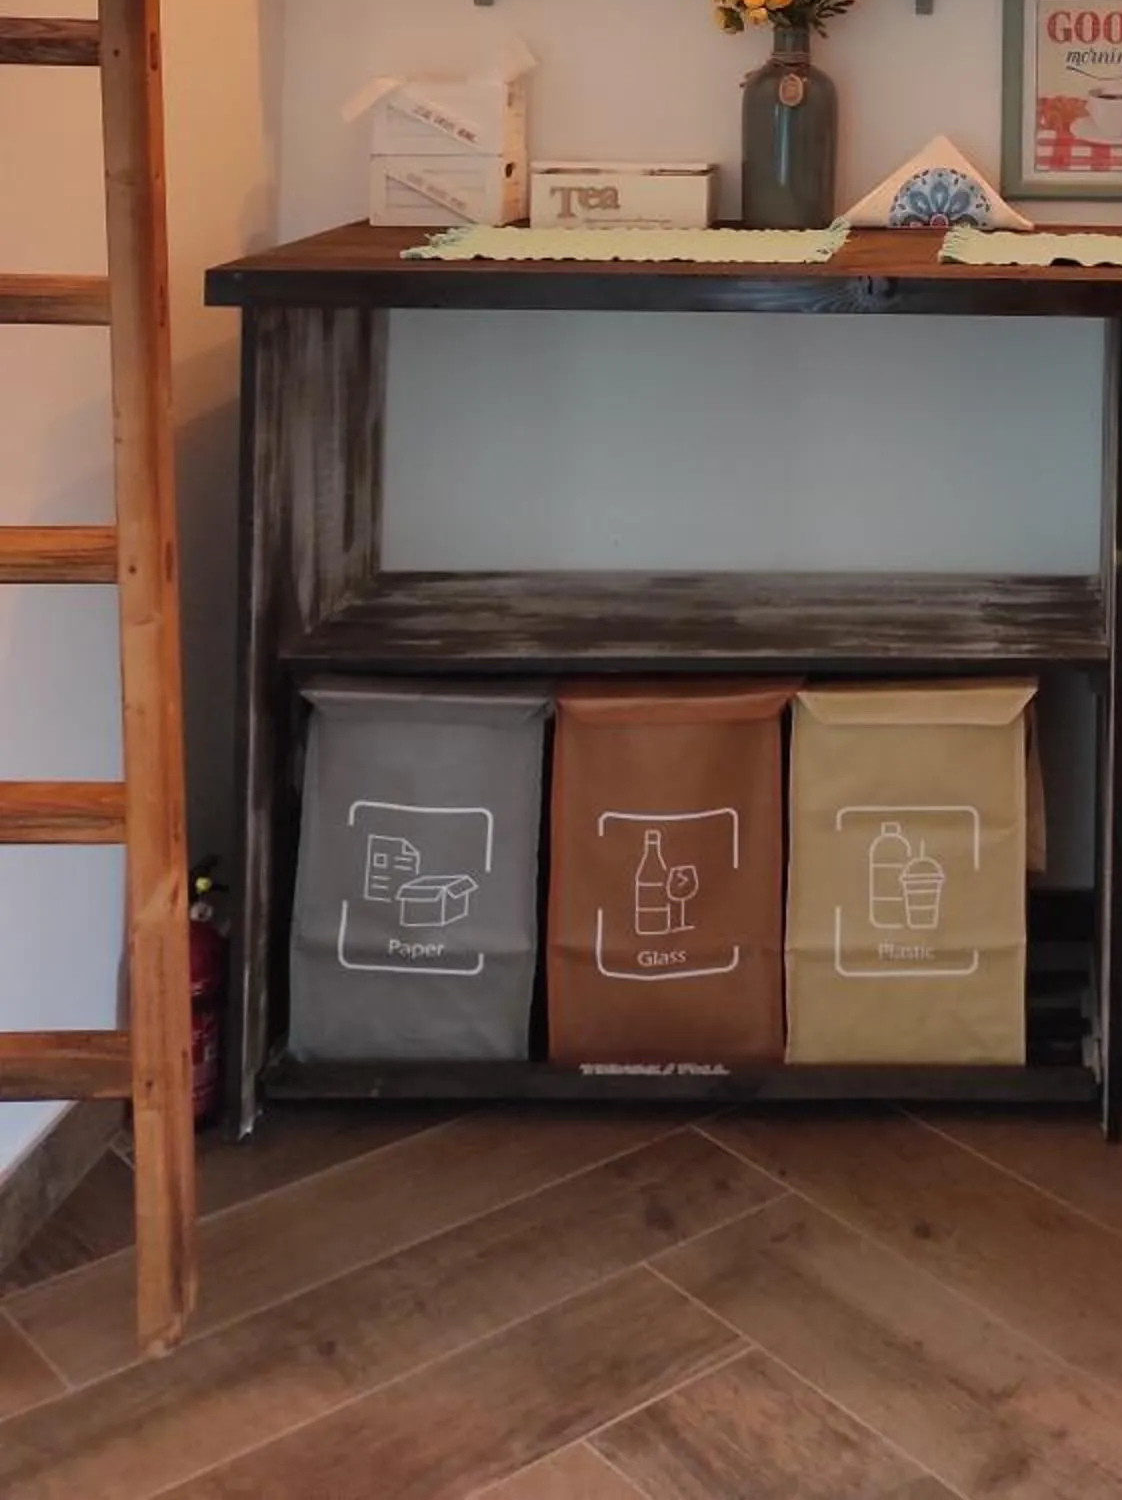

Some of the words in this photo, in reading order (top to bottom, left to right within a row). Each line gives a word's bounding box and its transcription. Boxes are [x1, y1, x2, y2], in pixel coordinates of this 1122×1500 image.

[550, 185, 621, 218] Tea
[389, 939, 446, 960] Paper
[637, 950, 687, 967] Glass
